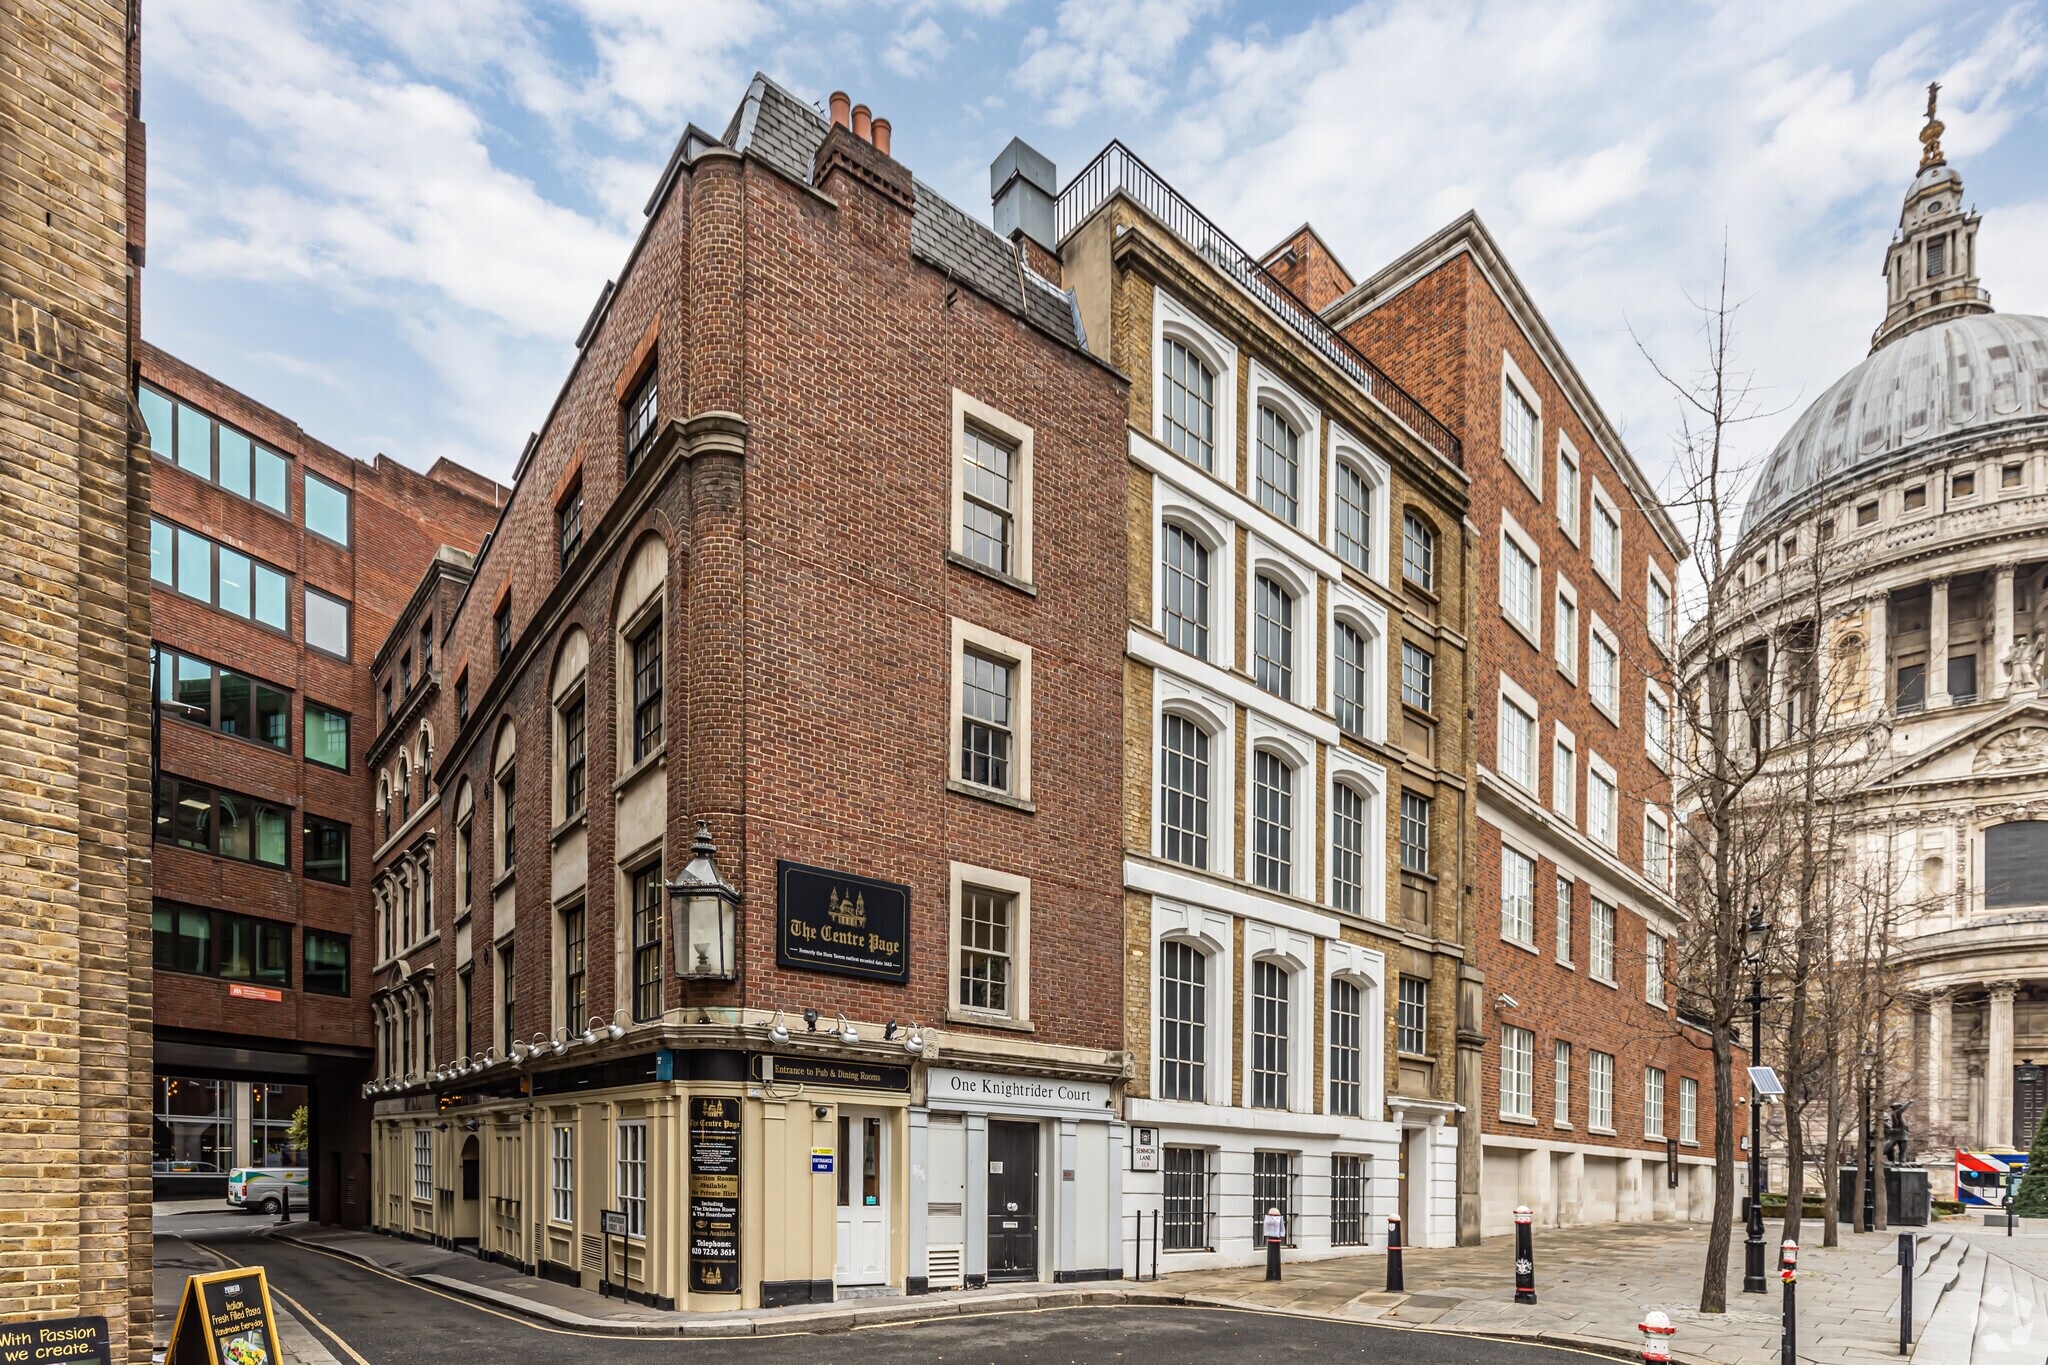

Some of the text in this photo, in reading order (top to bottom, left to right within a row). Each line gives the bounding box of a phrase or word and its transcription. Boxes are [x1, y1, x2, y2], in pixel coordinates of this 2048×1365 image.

[790, 919, 899, 956] The Centre Page
[799, 948, 815, 956] Formerly
[774, 1065, 881, 1081] Entrance to Pub & Dining Rooms
[951, 1076, 1090, 1102] One Knightrider Court
[724, 1120, 740, 1129] Page
[696, 1240, 731, 1248] Telephone:
[226, 1300, 244, 1311] Italian
[212, 1307, 261, 1325] Fresh Filled Pasta
[0, 1327, 96, 1347] With Passion
[215, 1324, 240, 1337] Handmade
[5, 1350, 28, 1362] we
